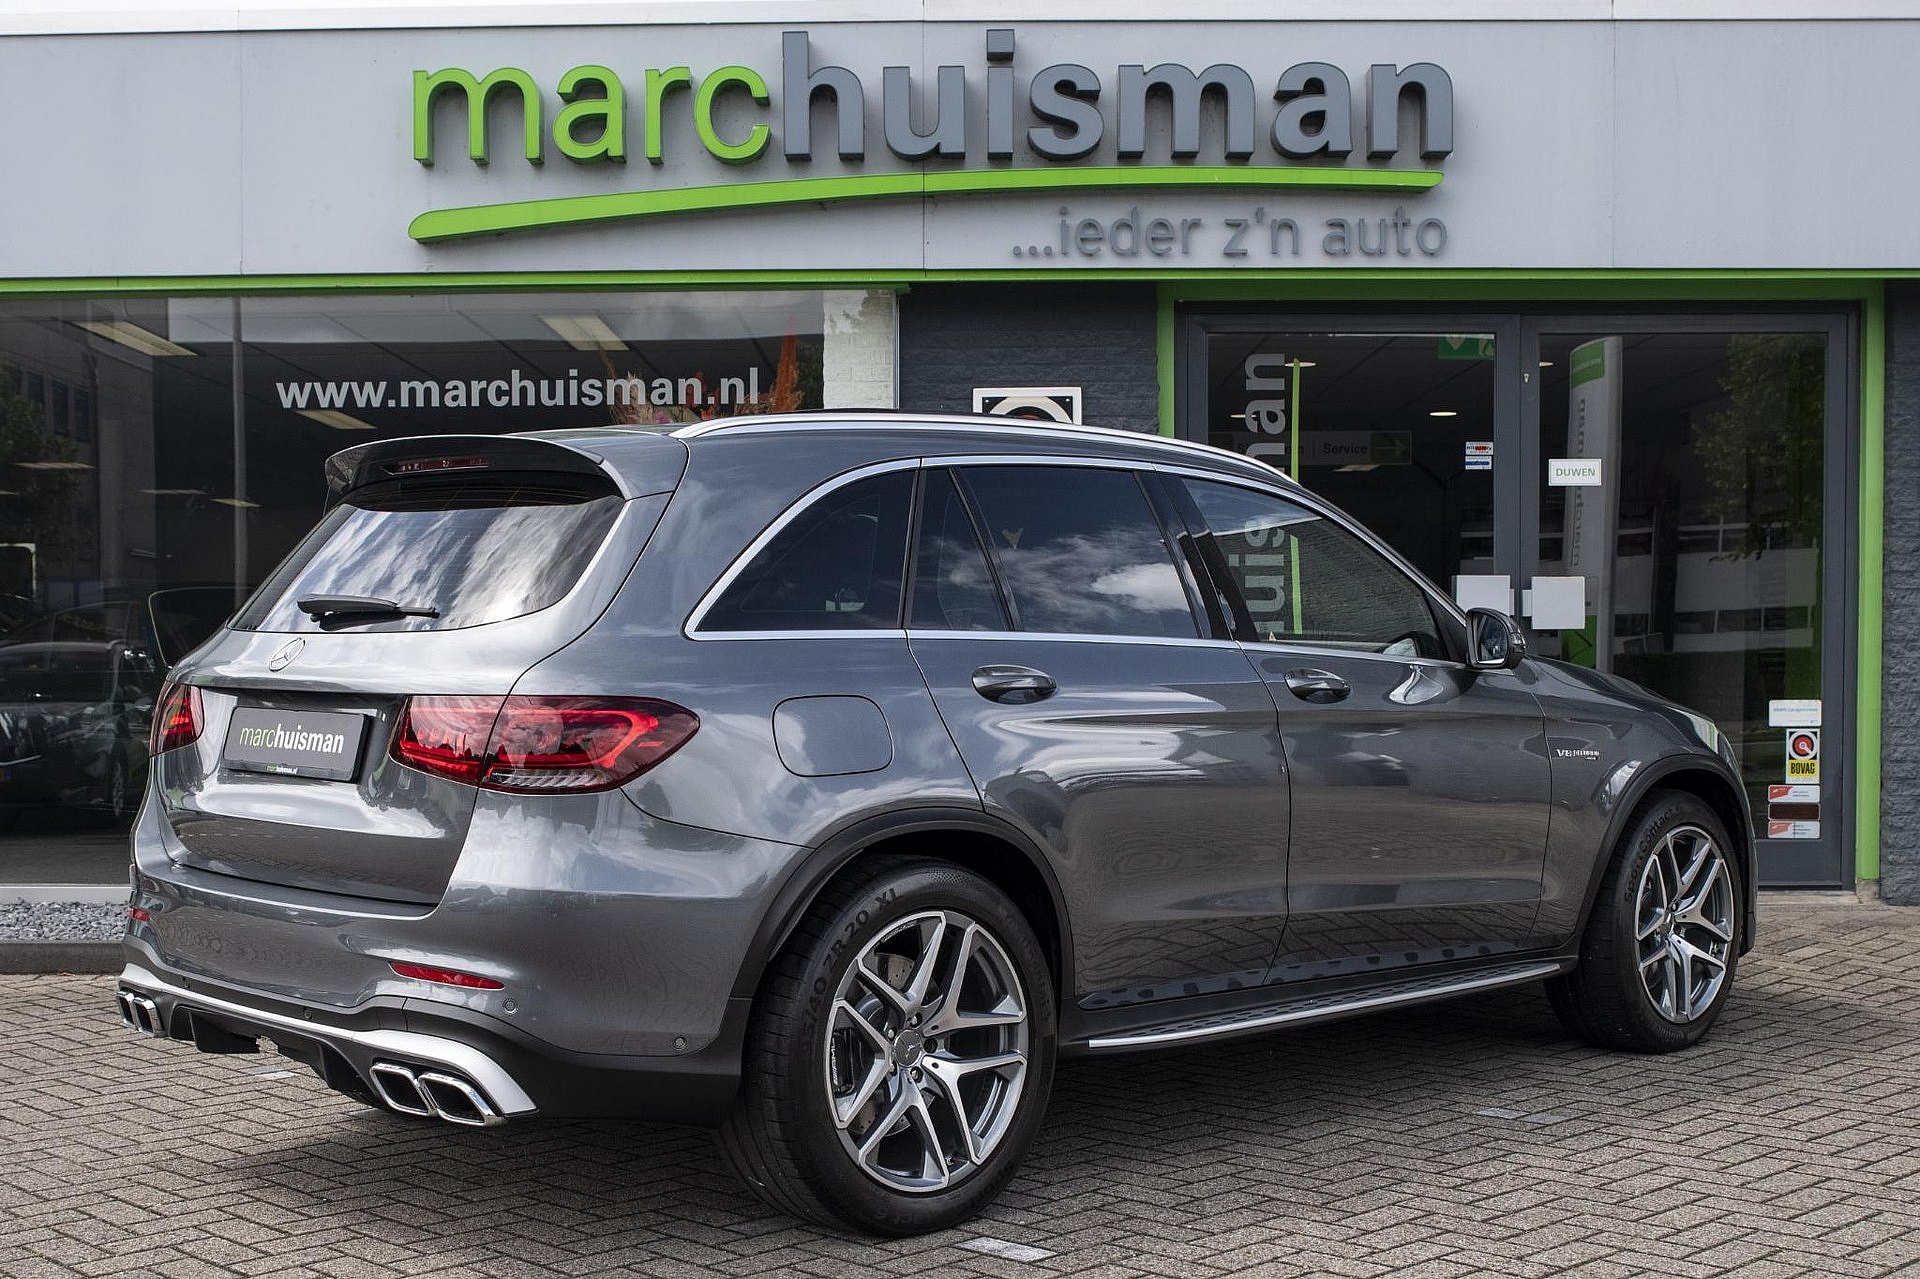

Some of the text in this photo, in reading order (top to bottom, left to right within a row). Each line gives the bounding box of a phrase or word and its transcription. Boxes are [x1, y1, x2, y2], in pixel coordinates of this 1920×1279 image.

[413, 29, 1456, 165] marchuisman
[1012, 206, 1448, 258] ...ieder z'n auto
[276, 367, 759, 408] www.marchuisman.nl
[1323, 442, 1367, 455] Service
[1555, 467, 1596, 478] DUWEN
[239, 723, 345, 754] marchuisman
[1790, 762, 1815, 775] BOVAG
[844, 910, 869, 938] 20
